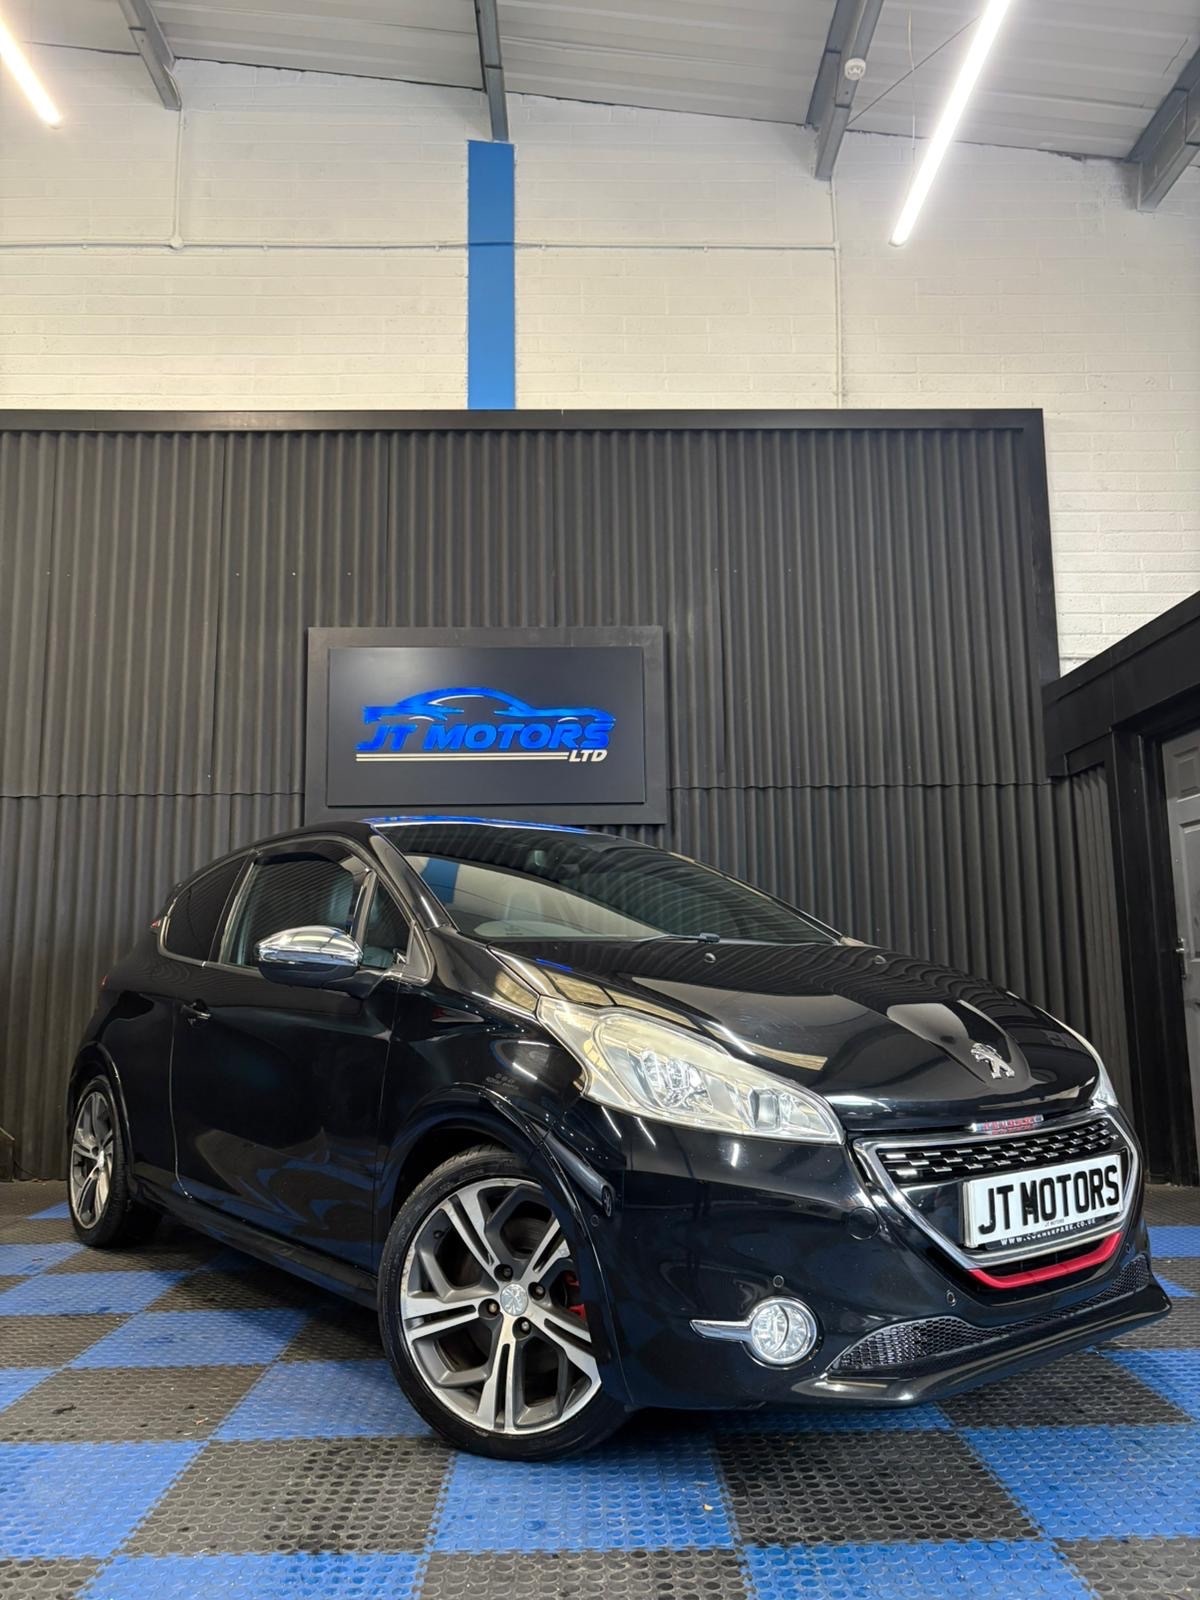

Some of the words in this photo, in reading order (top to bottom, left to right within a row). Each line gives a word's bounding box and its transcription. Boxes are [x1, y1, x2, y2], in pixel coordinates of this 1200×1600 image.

[356, 724, 418, 750] JT
[423, 723, 614, 749] MOTORS
[568, 749, 608, 762] LTD
[978, 1184, 1014, 1235] JT
[1020, 1164, 1120, 1226] MOTORS
